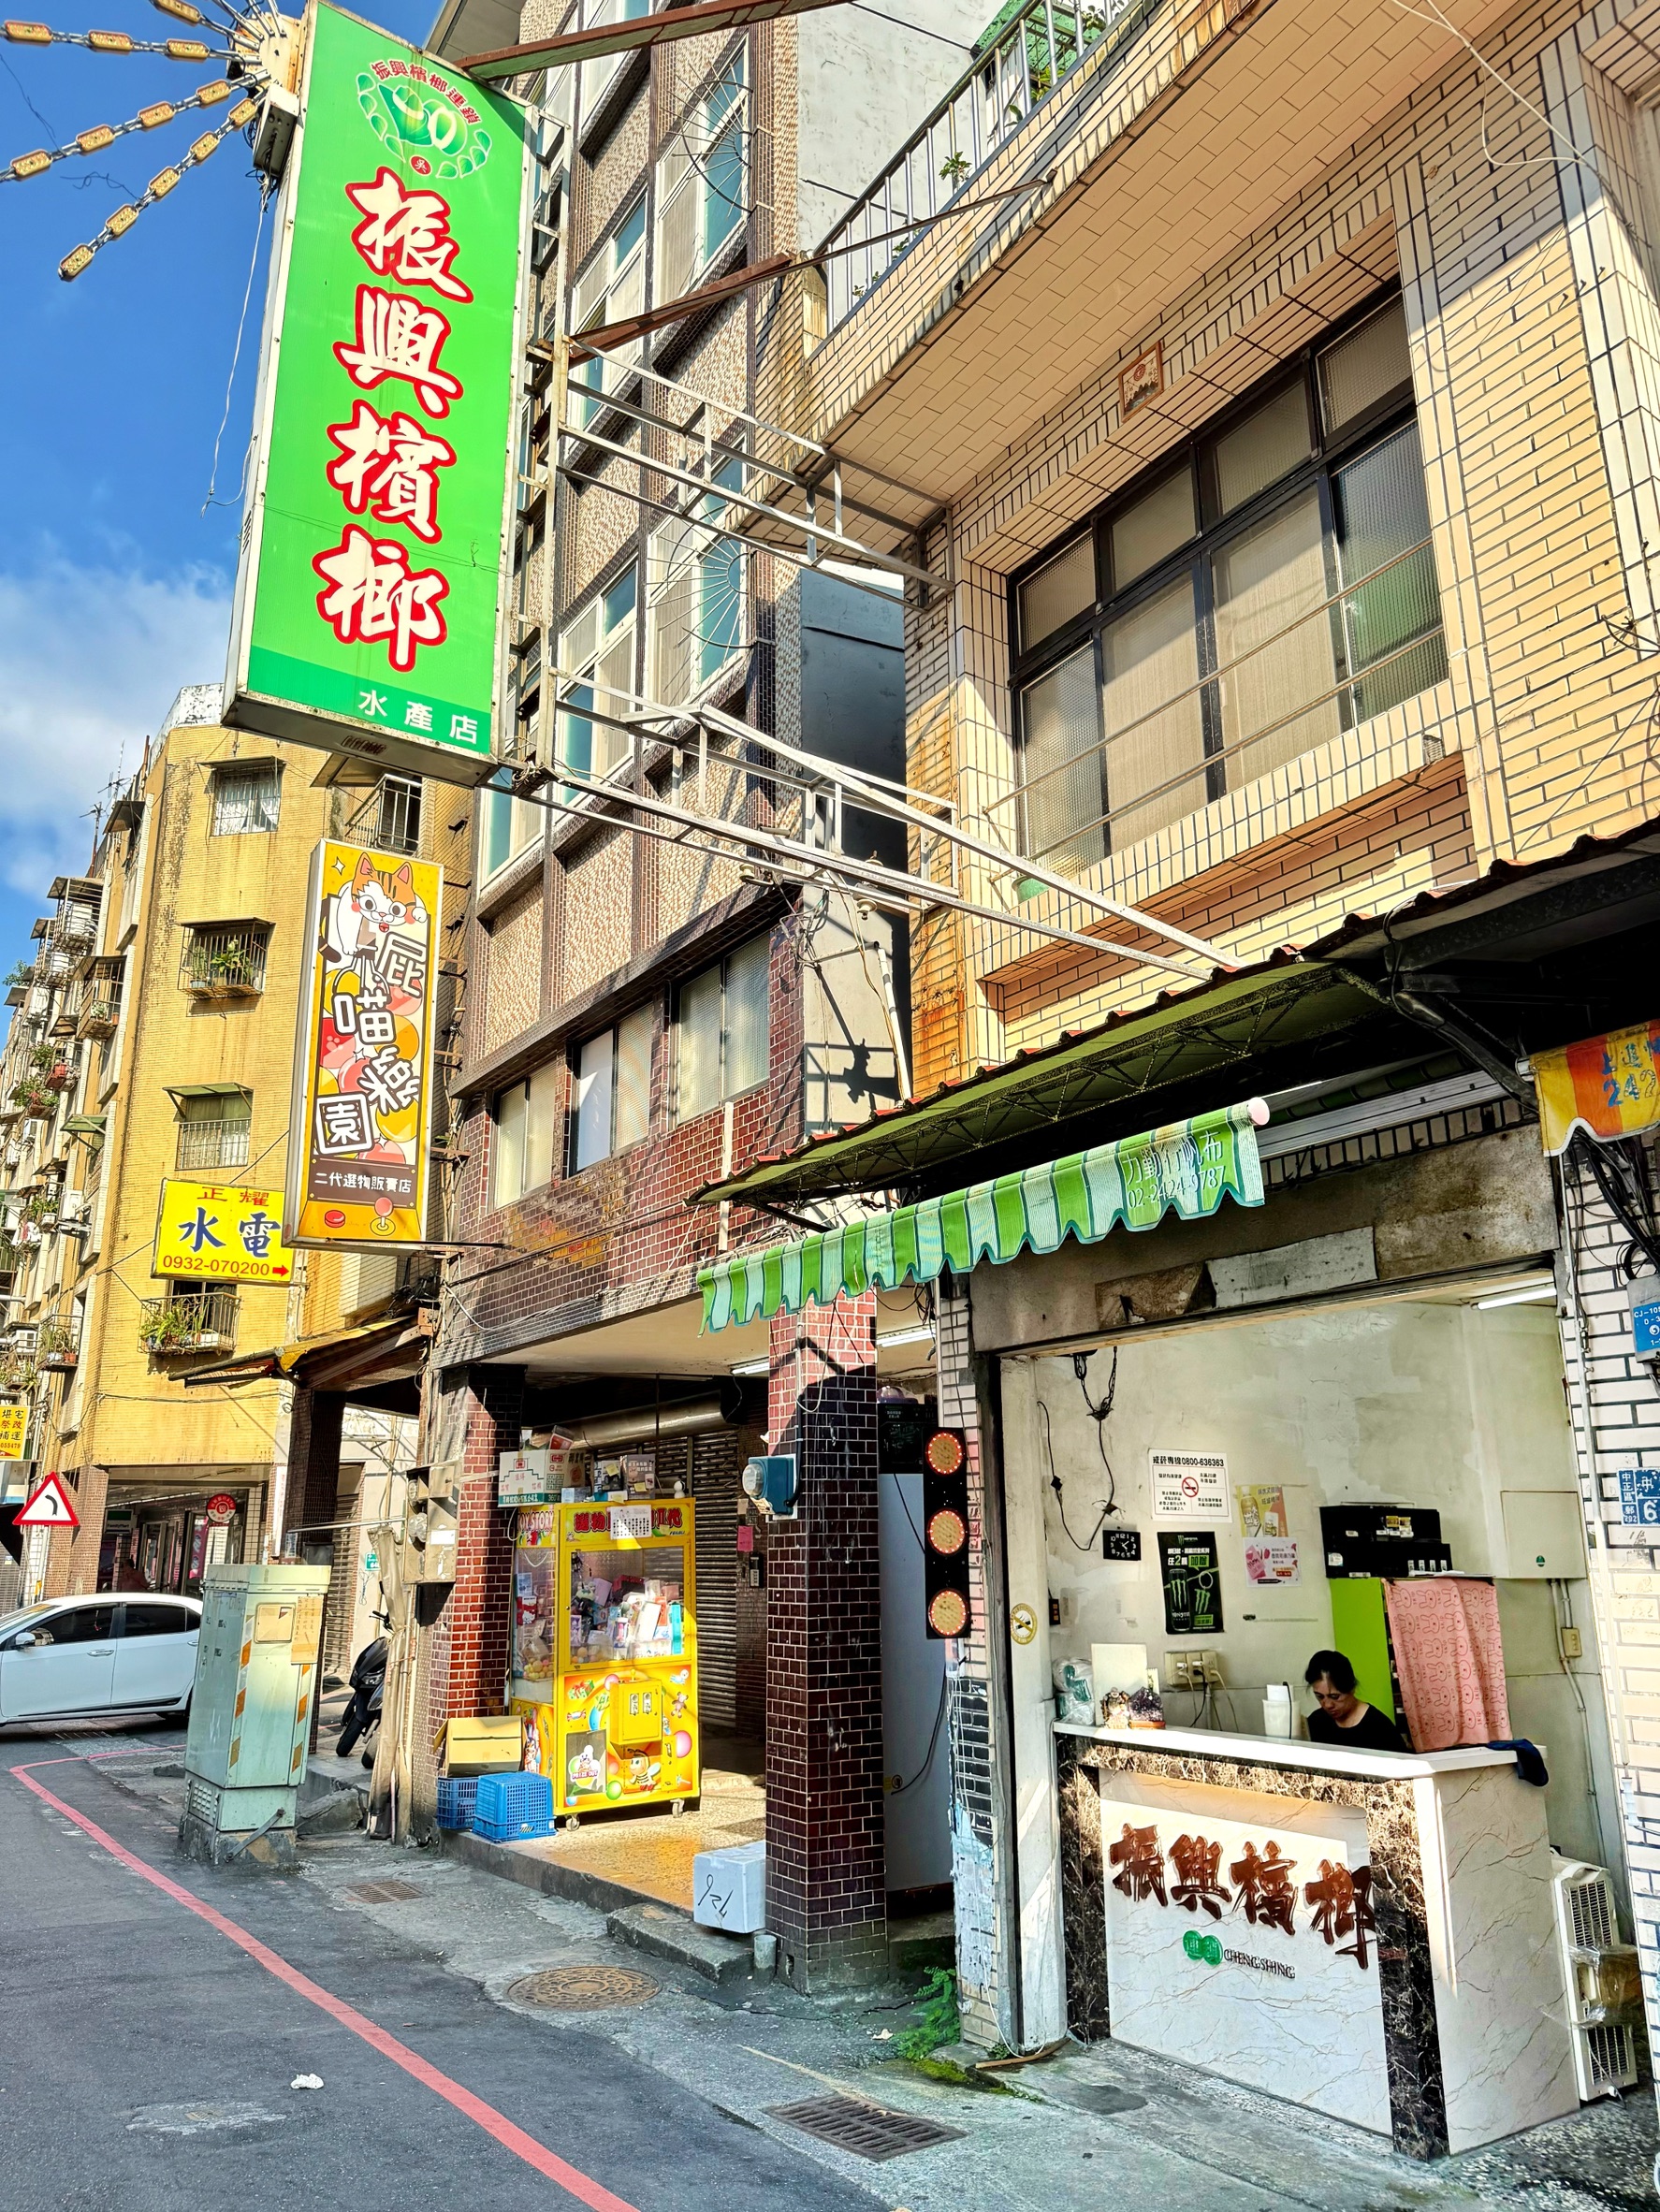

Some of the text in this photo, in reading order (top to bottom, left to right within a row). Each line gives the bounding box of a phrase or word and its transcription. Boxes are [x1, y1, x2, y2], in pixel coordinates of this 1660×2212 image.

[371, 60, 482, 124] 振興檳榔連鎖
[314, 167, 473, 671] 振興檳榔
[358, 690, 478, 745] 水產店
[314, 1171, 412, 1193] 二代選物販賣店
[1122, 1129, 1223, 1186] 力勤行帆布
[197, 1186, 269, 1208] 正耀
[1128, 1165, 1225, 1209] 02-2424-9787
[178, 1207, 282, 1259] 水電
[163, 1256, 270, 1276] 0932-070200
[1622, 1472, 1635, 1503] 中正區
[1110, 1823, 1376, 1970] 振興檳榔
